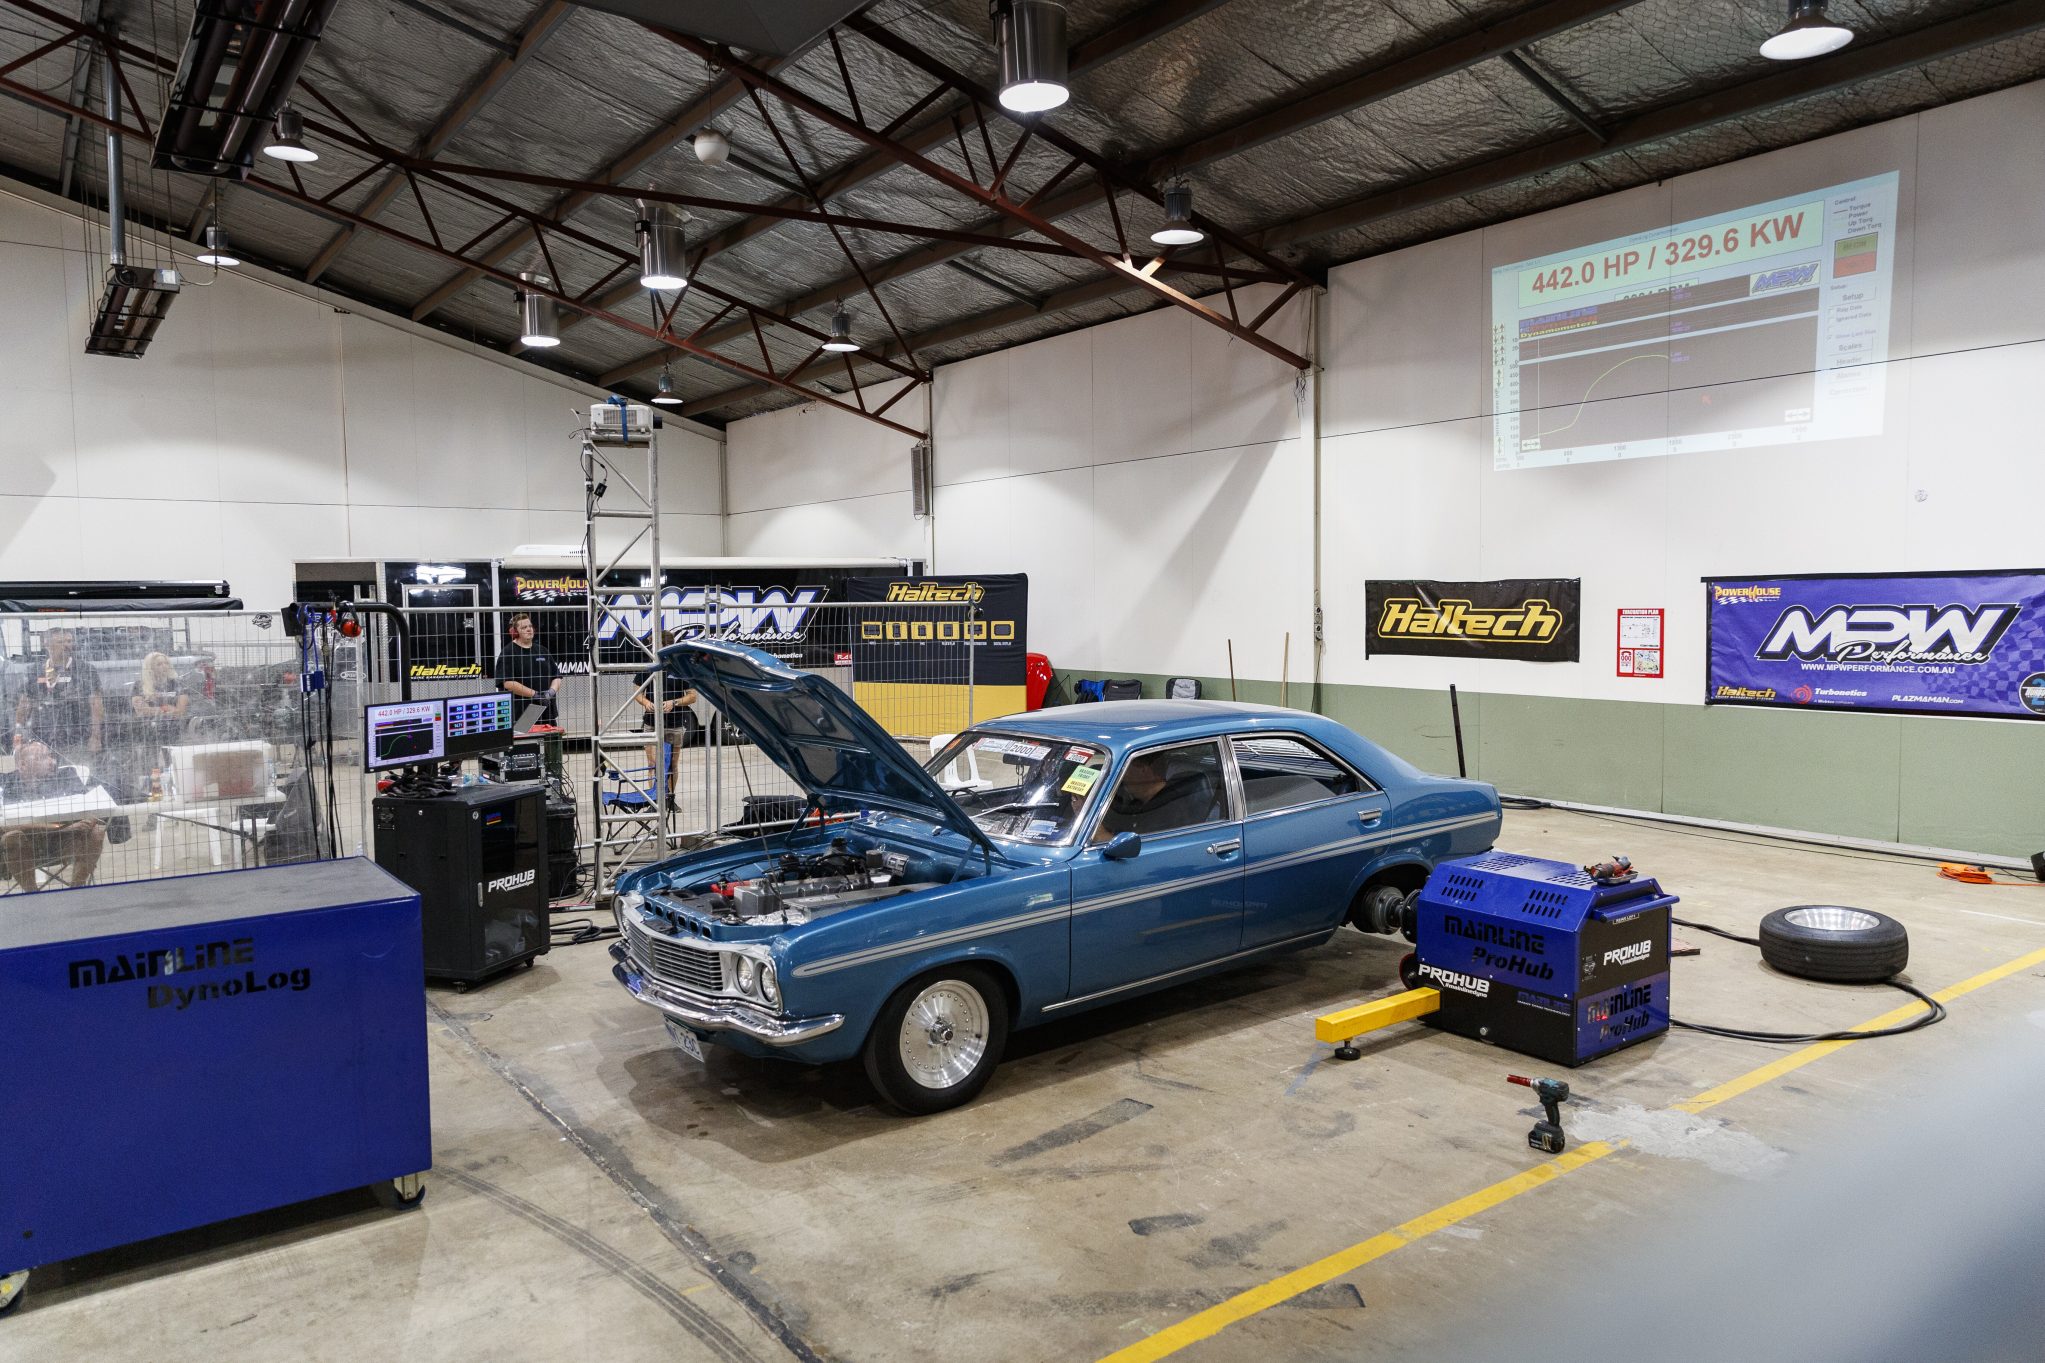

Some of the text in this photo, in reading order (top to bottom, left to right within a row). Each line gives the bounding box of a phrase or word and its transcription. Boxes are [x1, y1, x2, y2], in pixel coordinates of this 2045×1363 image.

[1849, 202, 1871, 211] Torque
[1848, 211, 1868, 219] Power
[1847, 226, 1866, 234] Down
[1532, 261, 1595, 294] 442.0
[1604, 251, 1640, 280] HP
[1647, 246, 1657, 270] /
[1665, 228, 1739, 266] 329.6
[1750, 212, 1804, 248] KW
[1842, 291, 1864, 302] Setup
[1520, 319, 1598, 338] Dynamometers
[1838, 343, 1863, 352] Scales
[516, 576, 588, 594] POWERHOU
[887, 582, 984, 602] Haltech
[1714, 585, 1781, 600] POWERHOUSE
[1380, 602, 1558, 639] Haltech
[1760, 606, 2012, 657] MPW
[1834, 640, 1988, 665] Performance
[410, 663, 482, 676] Haltech
[1801, 663, 1955, 674] WWW.MPWPERFORMANCE.COM.AU
[1716, 685, 1776, 698] Haltech
[1814, 687, 1868, 697] Turbonetics
[378, 709, 392, 717] 442.0
[406, 706, 420, 714] 329.6
[1010, 744, 1033, 755] 2000
[487, 869, 535, 892] PROHUB
[1603, 940, 1652, 966] PROHUB
[1472, 946, 1554, 980] ProHub
[1418, 963, 1490, 993] PROHUB
[147, 966, 312, 1011] DynoLog
[1444, 983, 1488, 998] #mainlinedyno
[1600, 1010, 1650, 1042] ProHub
